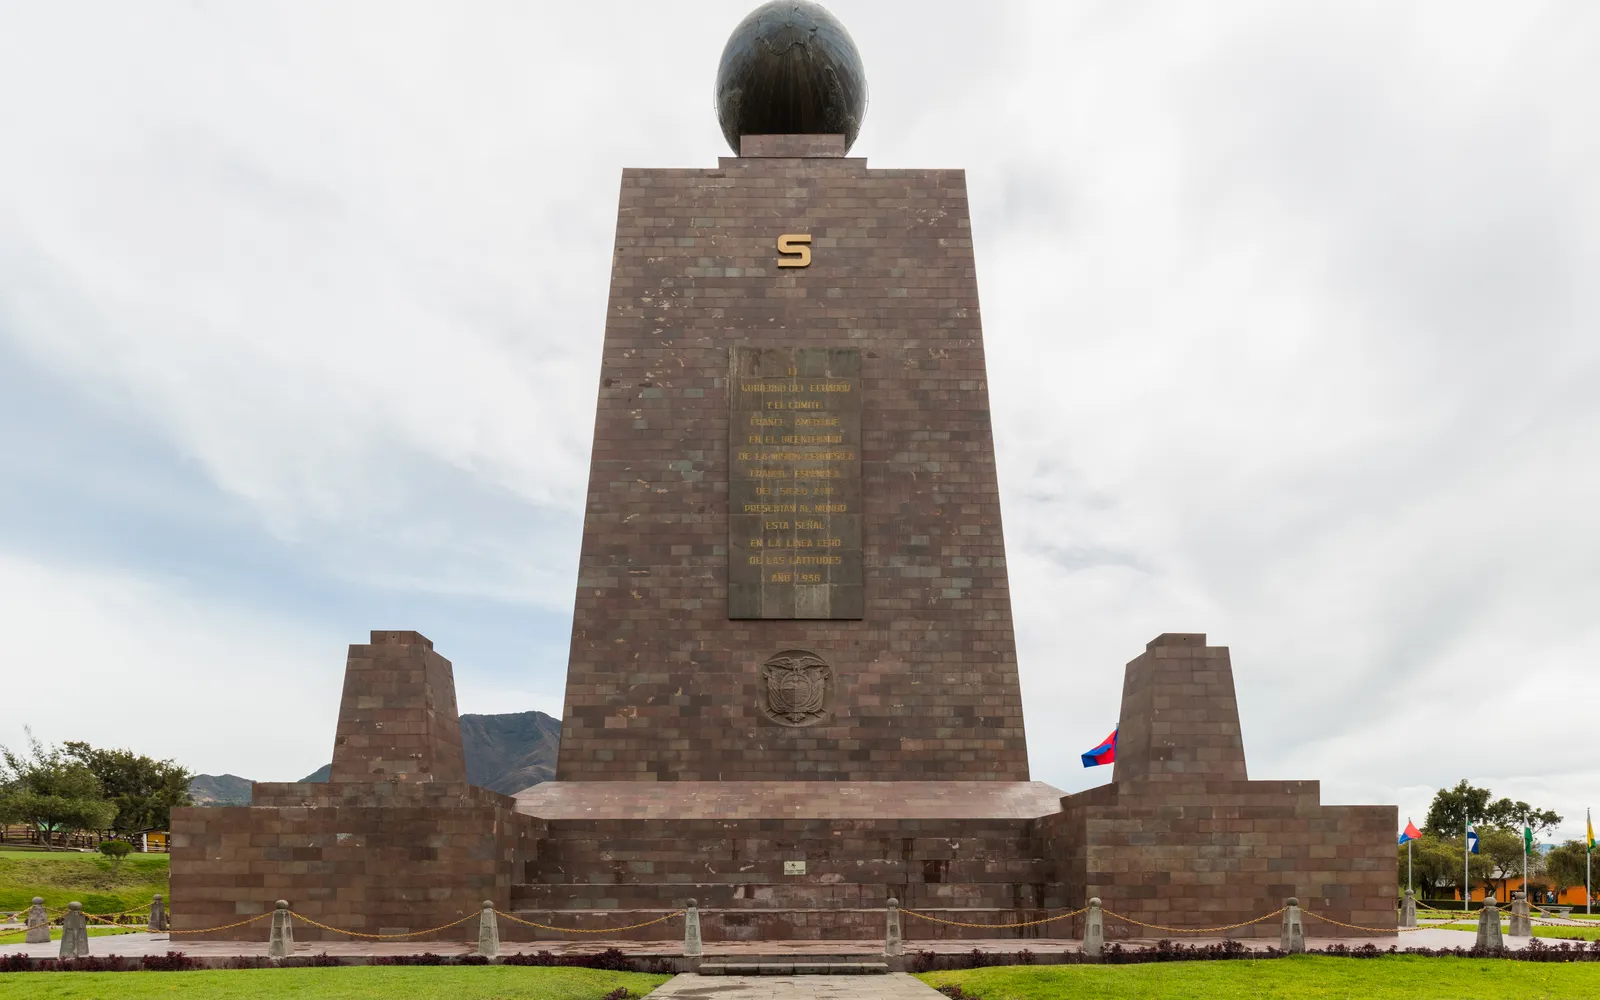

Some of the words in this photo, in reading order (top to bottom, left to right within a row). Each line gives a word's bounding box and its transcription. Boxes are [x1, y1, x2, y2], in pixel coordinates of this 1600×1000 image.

[778, 234, 812, 267] S
[766, 400, 772, 409] Y
[774, 400, 785, 409] EL
[749, 436, 762, 444] EN
[766, 436, 776, 444] EL
[800, 504, 812, 512] AL
[765, 521, 790, 530] ESTA
[795, 520, 824, 530] SEÑAL
[750, 539, 763, 548] EN
[768, 539, 781, 548] LA
[749, 556, 762, 564] DE
[766, 556, 784, 564] LAS
[789, 556, 842, 564] LATITUDES
